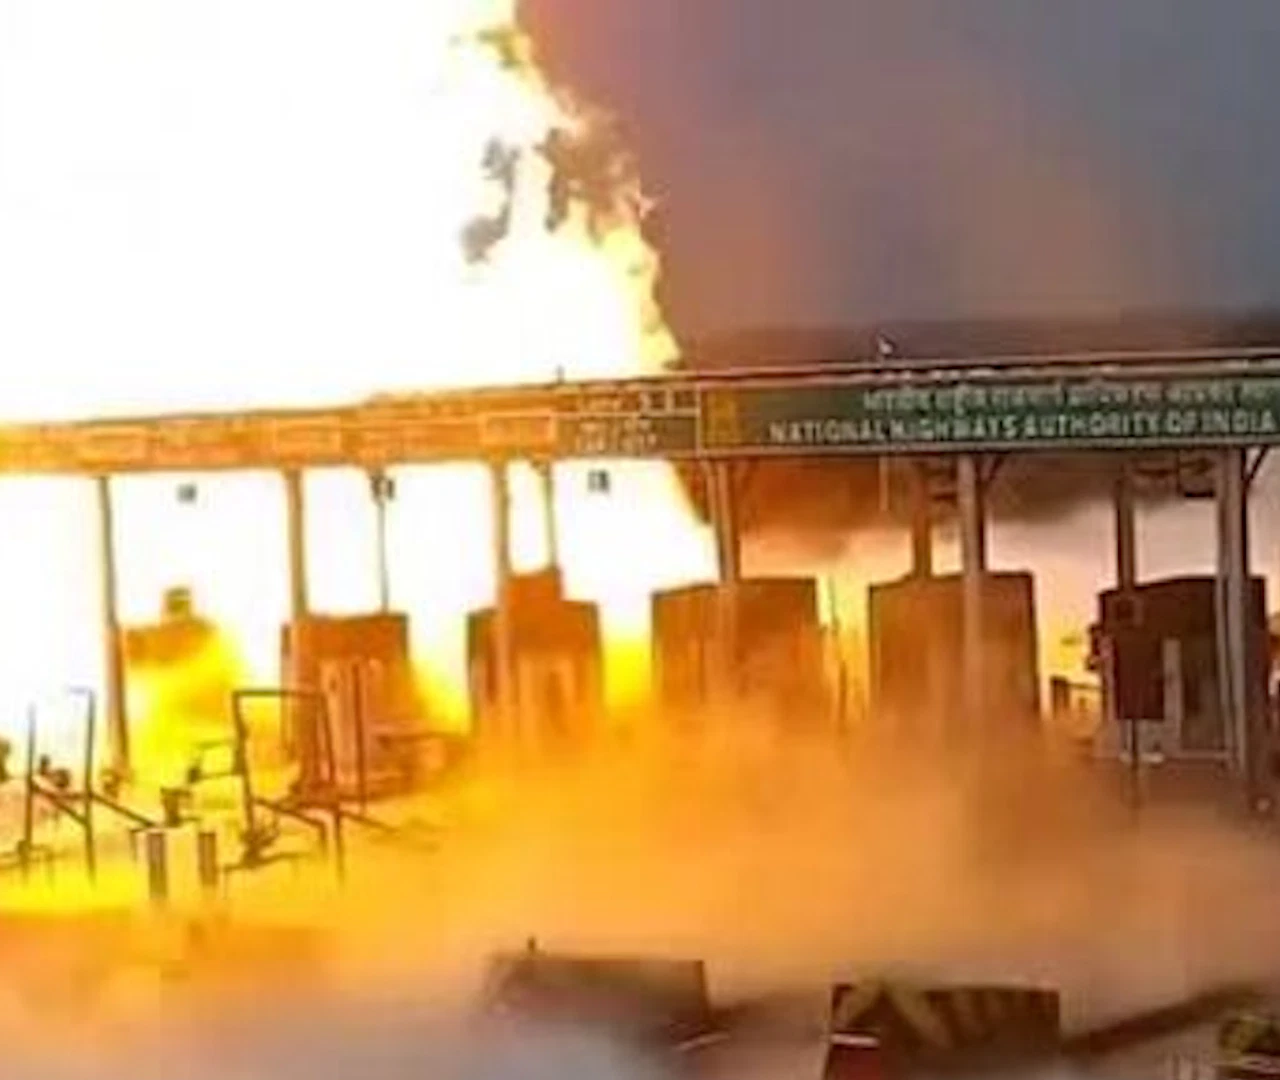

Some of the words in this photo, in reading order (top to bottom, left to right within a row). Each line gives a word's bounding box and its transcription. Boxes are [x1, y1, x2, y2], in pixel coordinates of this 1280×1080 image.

[769, 419, 887, 444] NATIONAL
[891, 416, 1017, 441] HIGHWAYS
[1023, 412, 1161, 438] AUTHORITY
[1165, 411, 1200, 436] OF
[1202, 409, 1275, 435] INDIA
